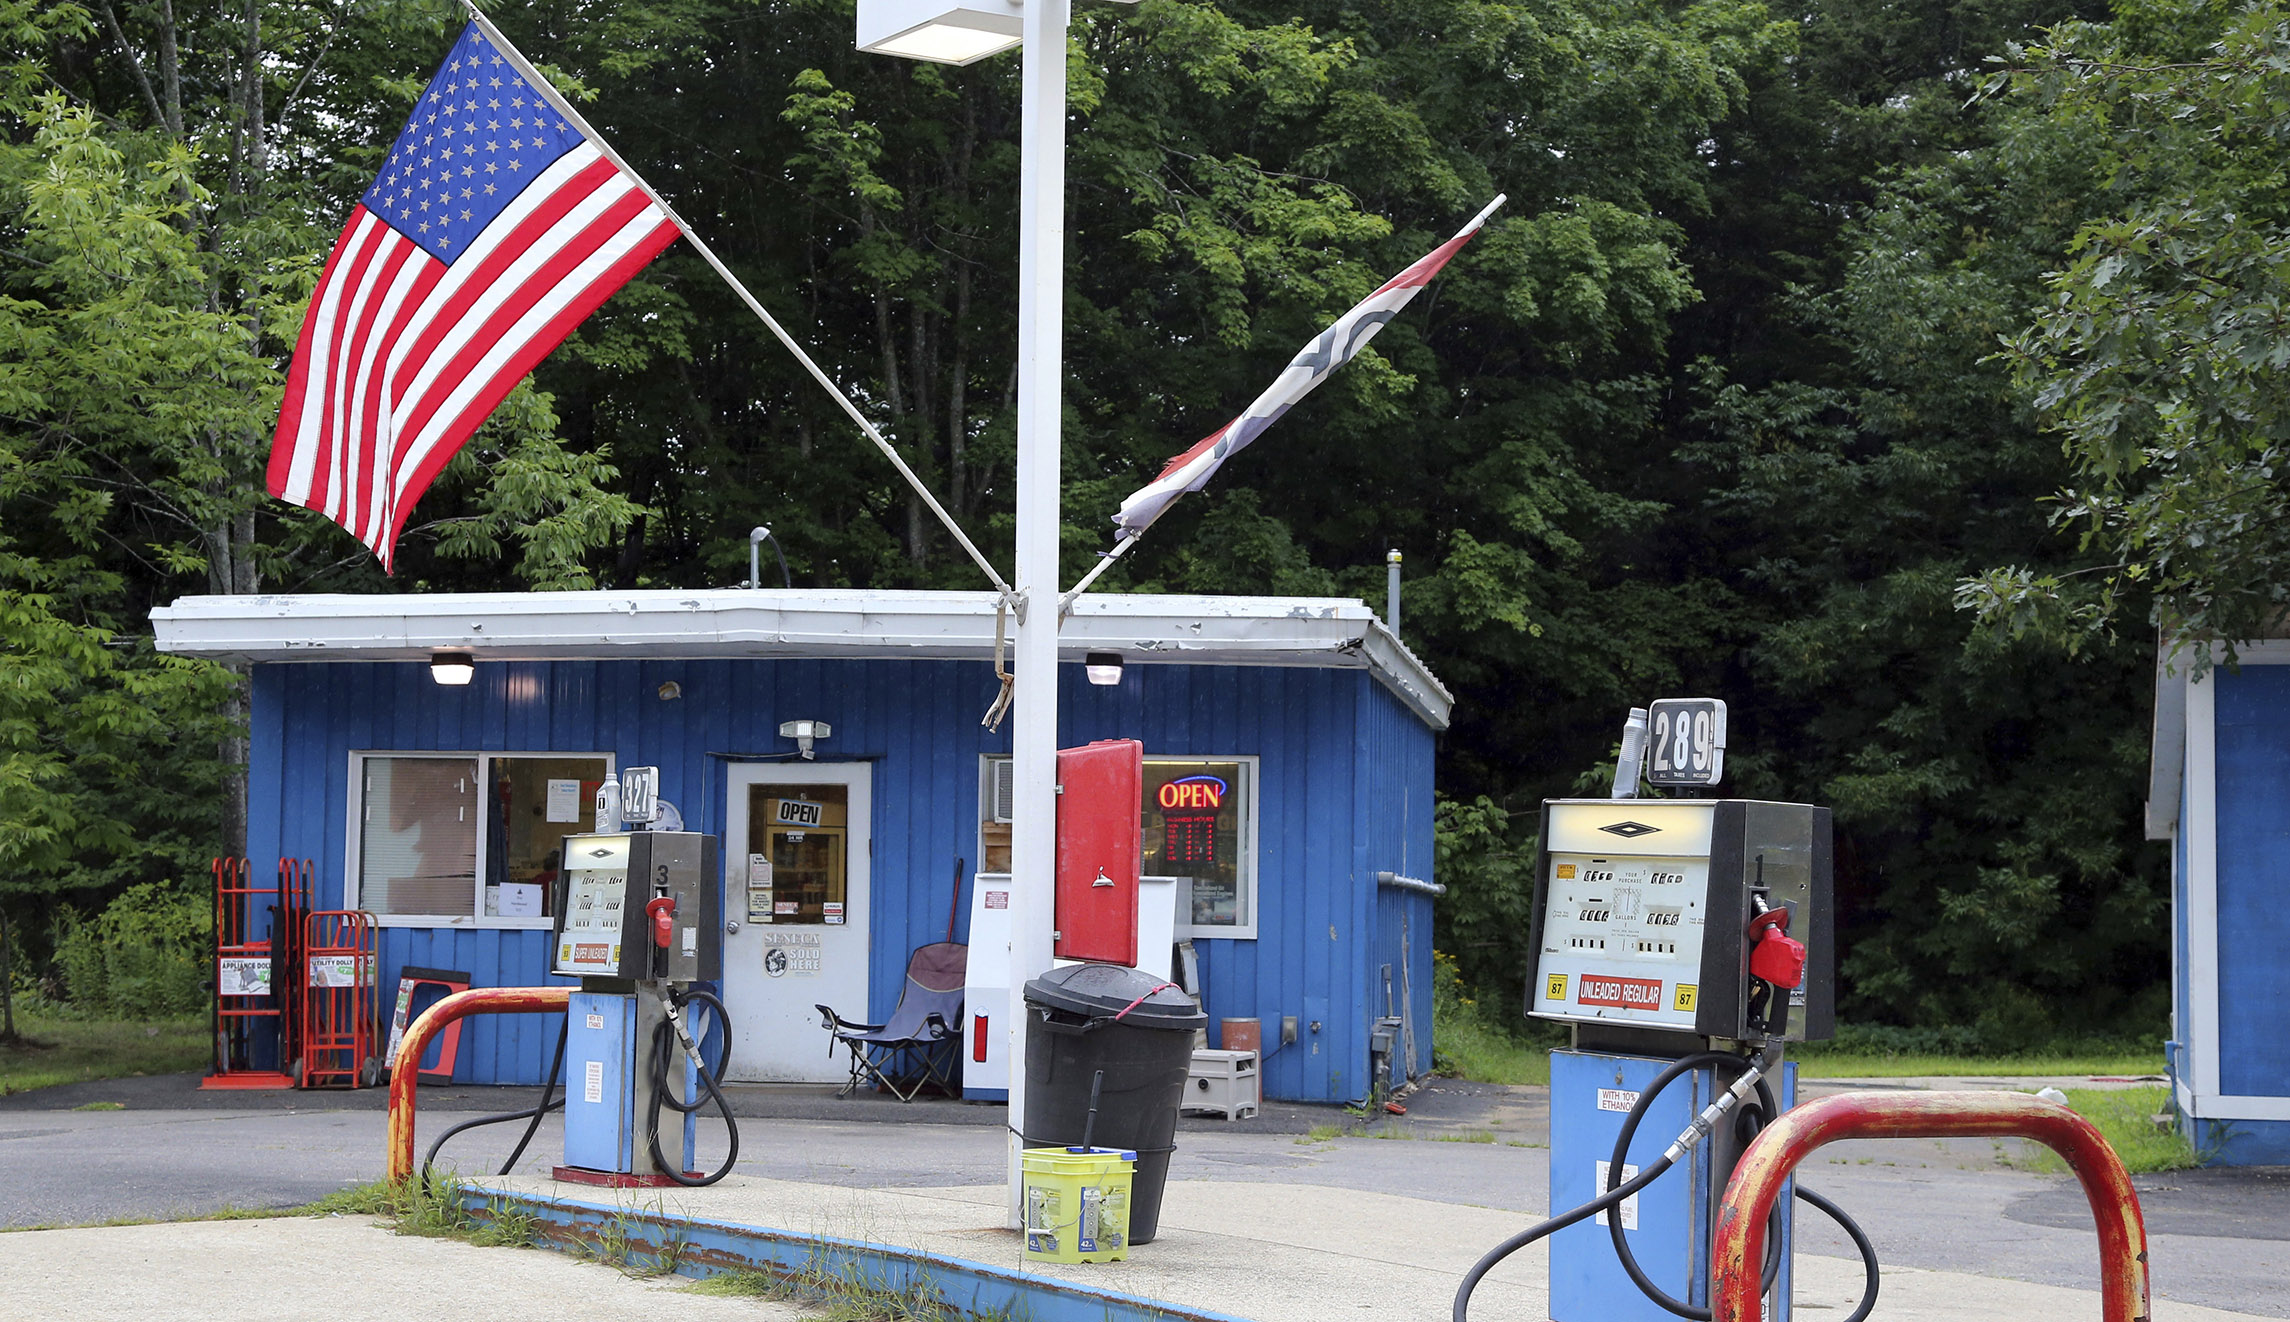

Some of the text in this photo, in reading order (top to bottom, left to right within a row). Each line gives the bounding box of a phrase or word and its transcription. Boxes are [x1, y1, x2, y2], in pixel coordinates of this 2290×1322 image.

[1159, 782, 1220, 808] OPEN
[780, 801, 819, 824] OPEN
[656, 865, 669, 885] 3
[764, 933, 820, 944] SENECA
[575, 947, 608, 960] SUPER UNLEADED
[790, 949, 820, 960] SOLD
[222, 962, 271, 970] APPLIANCE DOLL
[790, 960, 820, 971] HERE
[1551, 983, 1562, 994] 87
[1580, 981, 1660, 1004] UNLEADED REGULAR
[1679, 994, 1691, 1005] 87
[1602, 1090, 1636, 1101] WITH 10%
